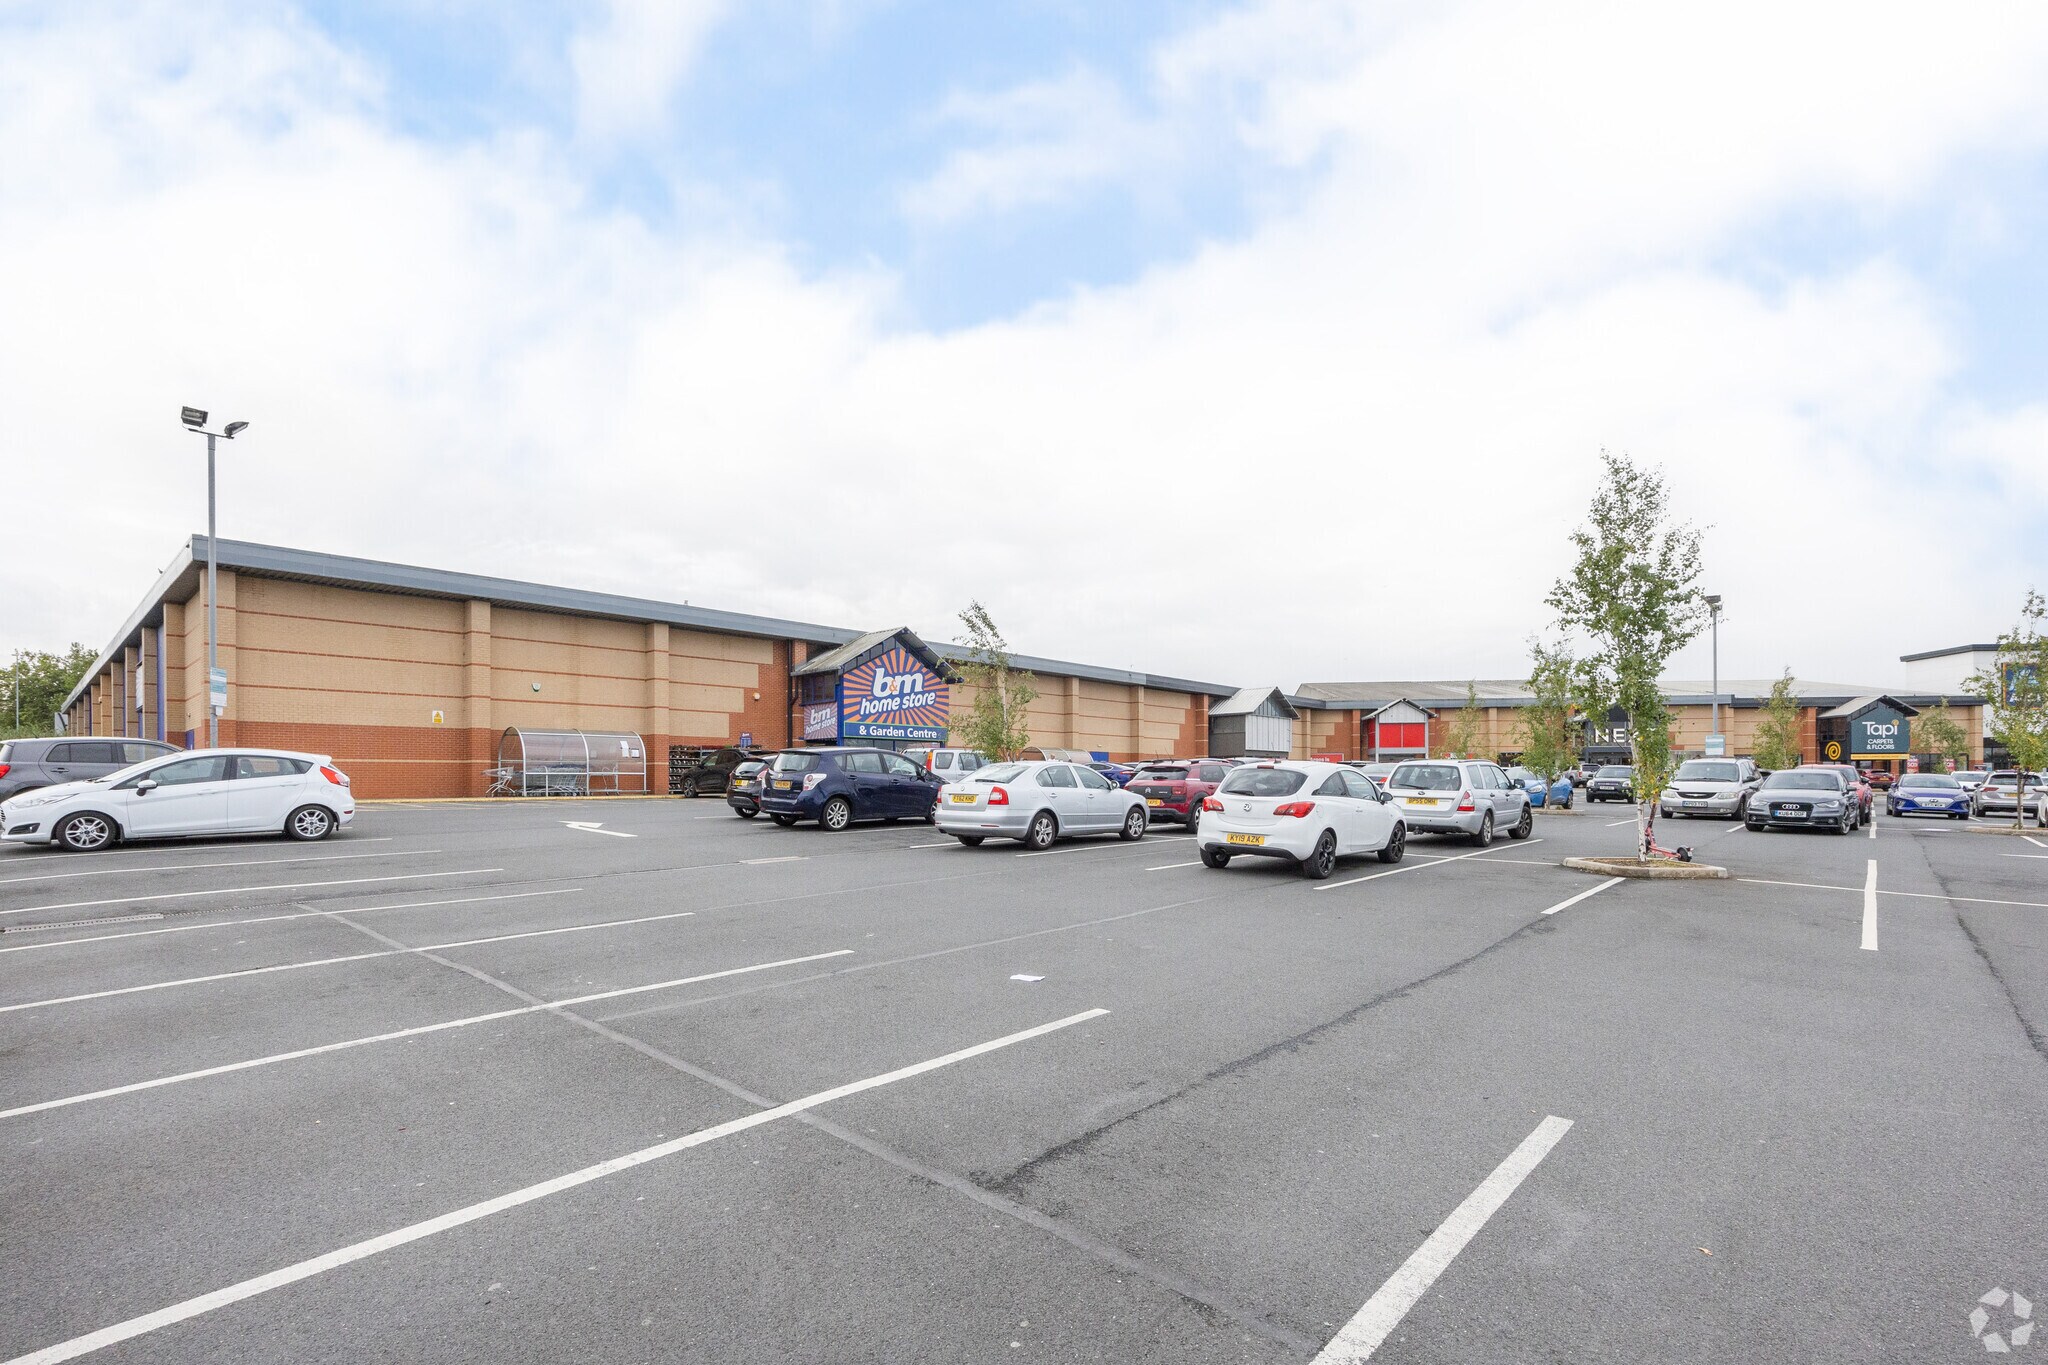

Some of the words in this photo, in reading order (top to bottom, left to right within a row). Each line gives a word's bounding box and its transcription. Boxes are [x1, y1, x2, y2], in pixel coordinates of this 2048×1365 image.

[873, 667, 924, 698] b&m
[860, 697, 901, 715] home
[902, 692, 936, 709] store
[806, 721, 822, 734] home
[821, 716, 836, 729] store
[859, 725, 867, 736] &
[869, 725, 905, 737] Garden
[907, 727, 938, 739] Centre
[1862, 719, 1900, 738] Tapi
[1229, 834, 1246, 843] KY19
[1246, 835, 1261, 843] AZK
